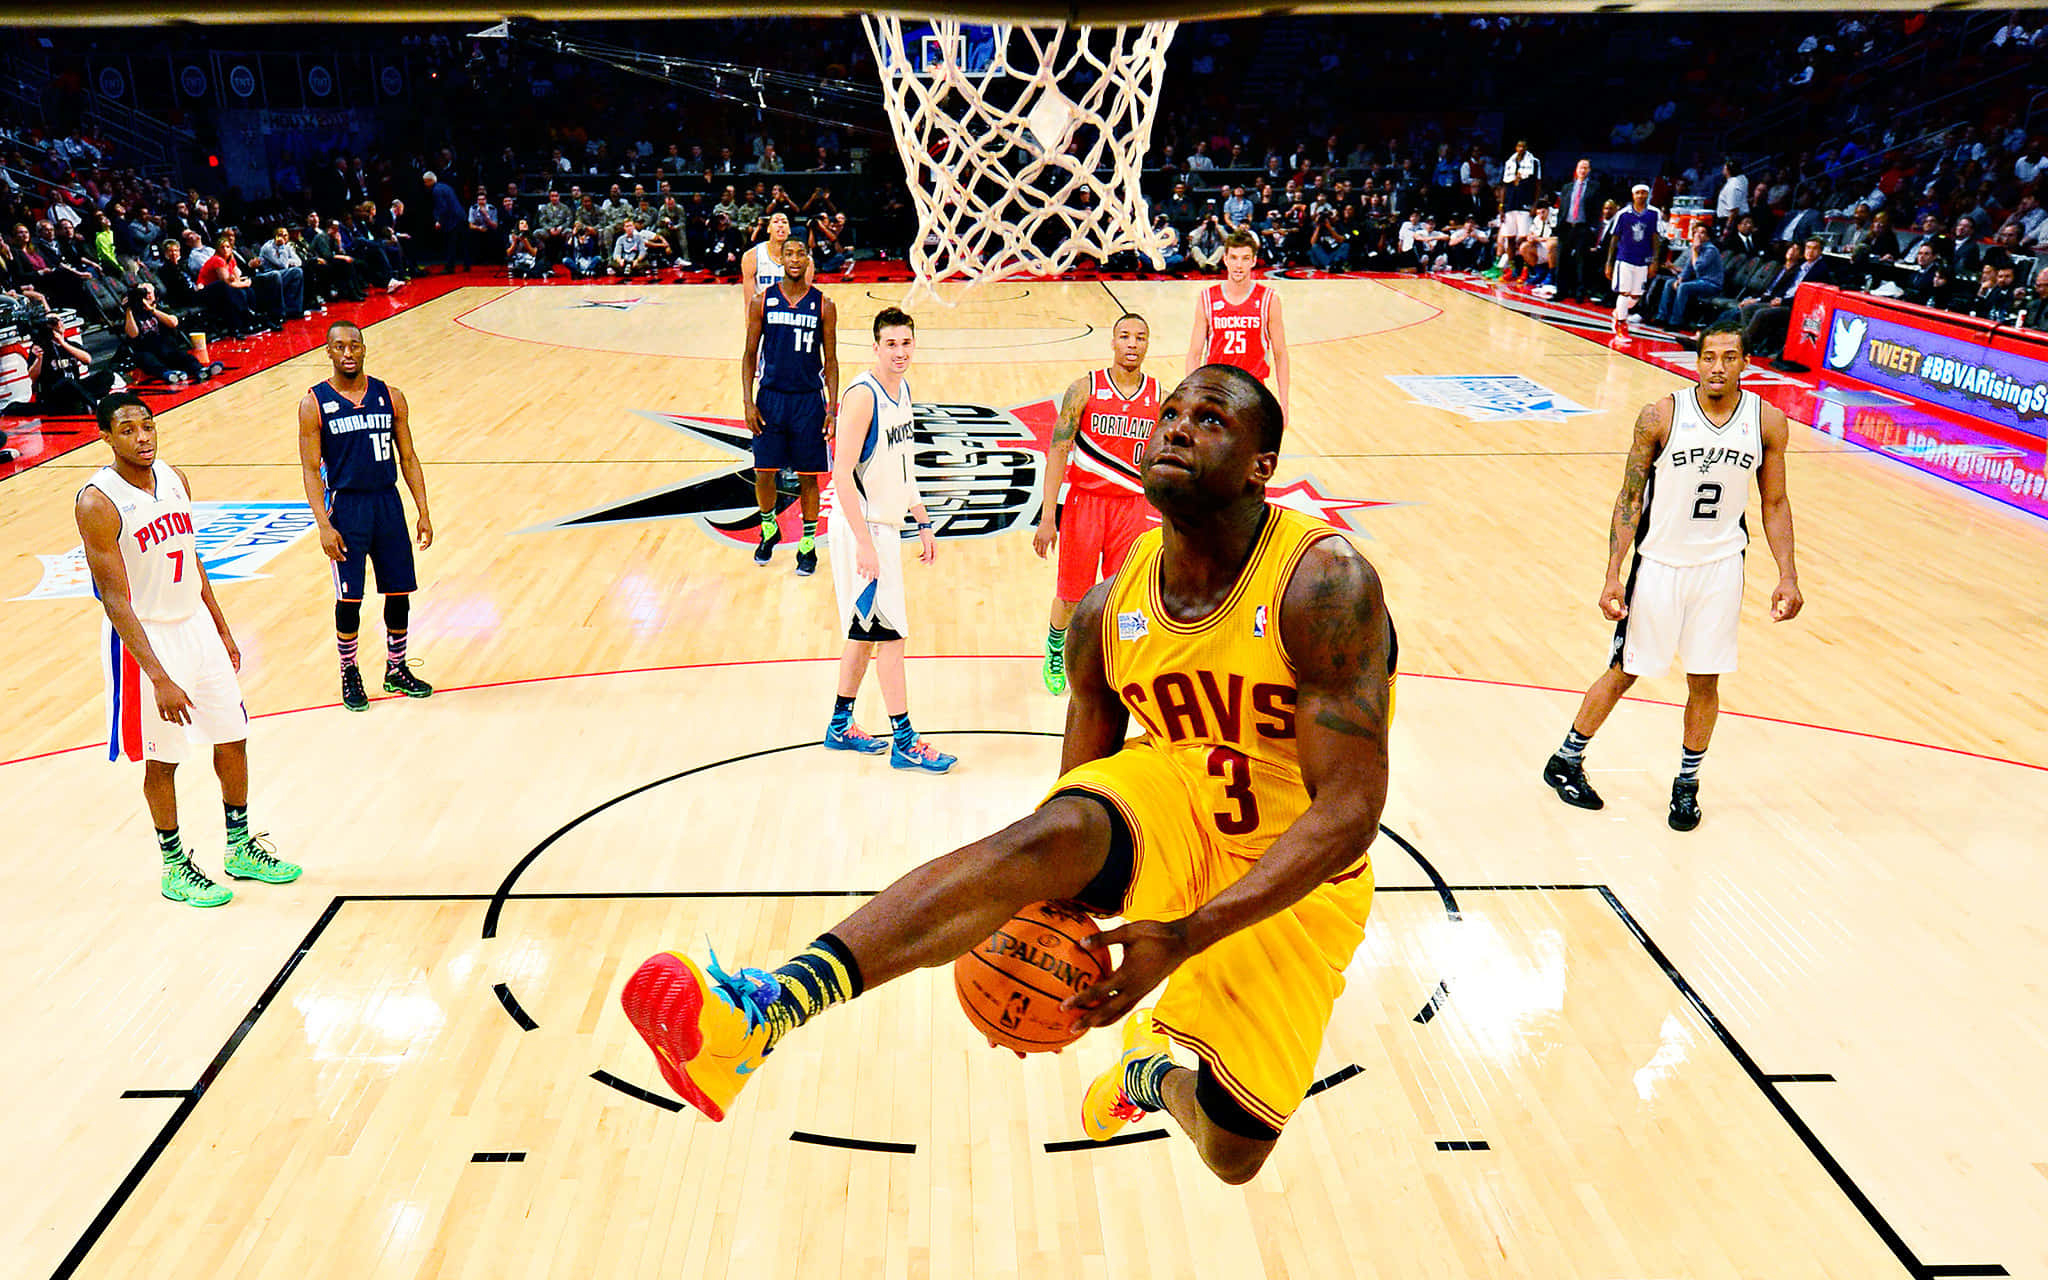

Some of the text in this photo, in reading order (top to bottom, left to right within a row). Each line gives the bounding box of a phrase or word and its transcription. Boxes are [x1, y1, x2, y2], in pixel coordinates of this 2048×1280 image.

[767, 311, 818, 329] CHARLOTTE
[1214, 316, 1260, 329] ROCKETS
[793, 328, 815, 353] 14
[1223, 331, 1247, 354] 25
[1868, 339, 2048, 415] TWEET #BBVARisingS
[328, 413, 392, 435] CHARLOTTE
[369, 432, 392, 462] 15
[1133, 441, 1145, 465] 0
[1671, 447, 1755, 474] SPURS
[1690, 481, 1725, 521] 2
[166, 549, 184, 584] 7
[1121, 670, 1297, 744] CAVS
[1206, 744, 1260, 836] 3
[985, 930, 1093, 994] SPALDING
